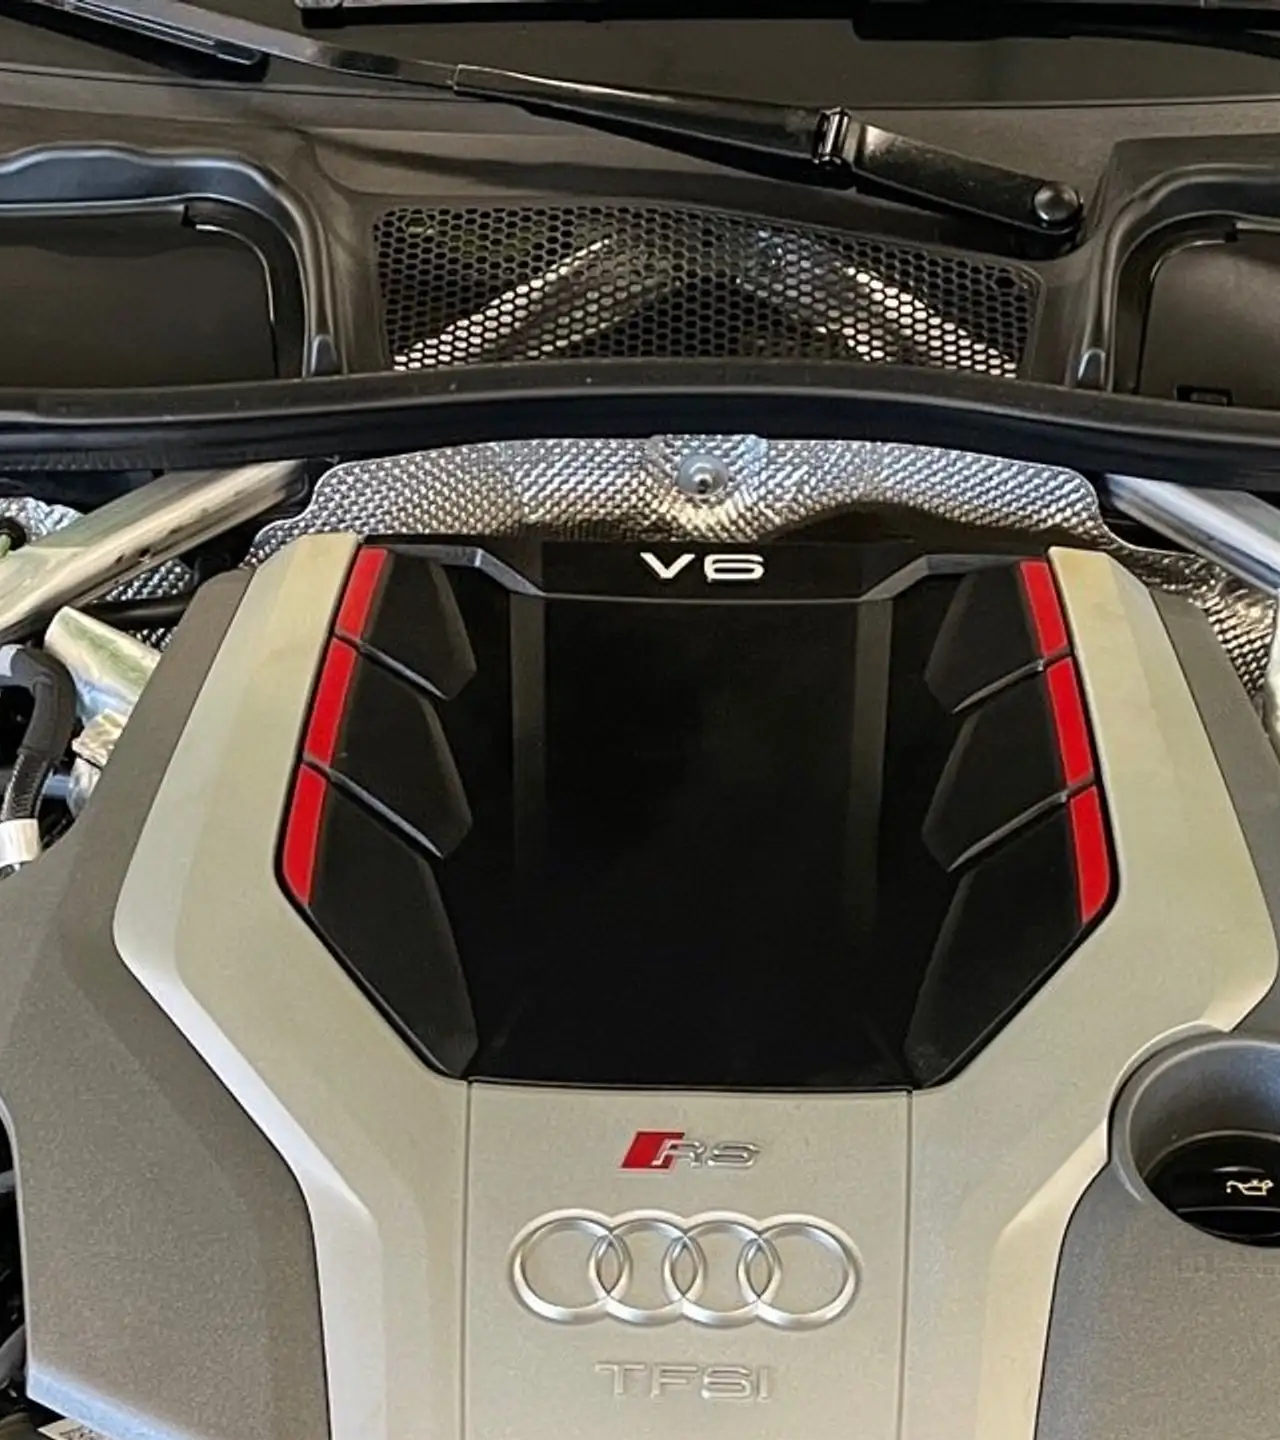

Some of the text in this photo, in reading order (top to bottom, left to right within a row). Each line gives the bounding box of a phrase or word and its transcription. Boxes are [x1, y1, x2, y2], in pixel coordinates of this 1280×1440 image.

[640, 552, 765, 583] V6
[650, 1137, 762, 1171] RS
[594, 1360, 772, 1403] TFSI
